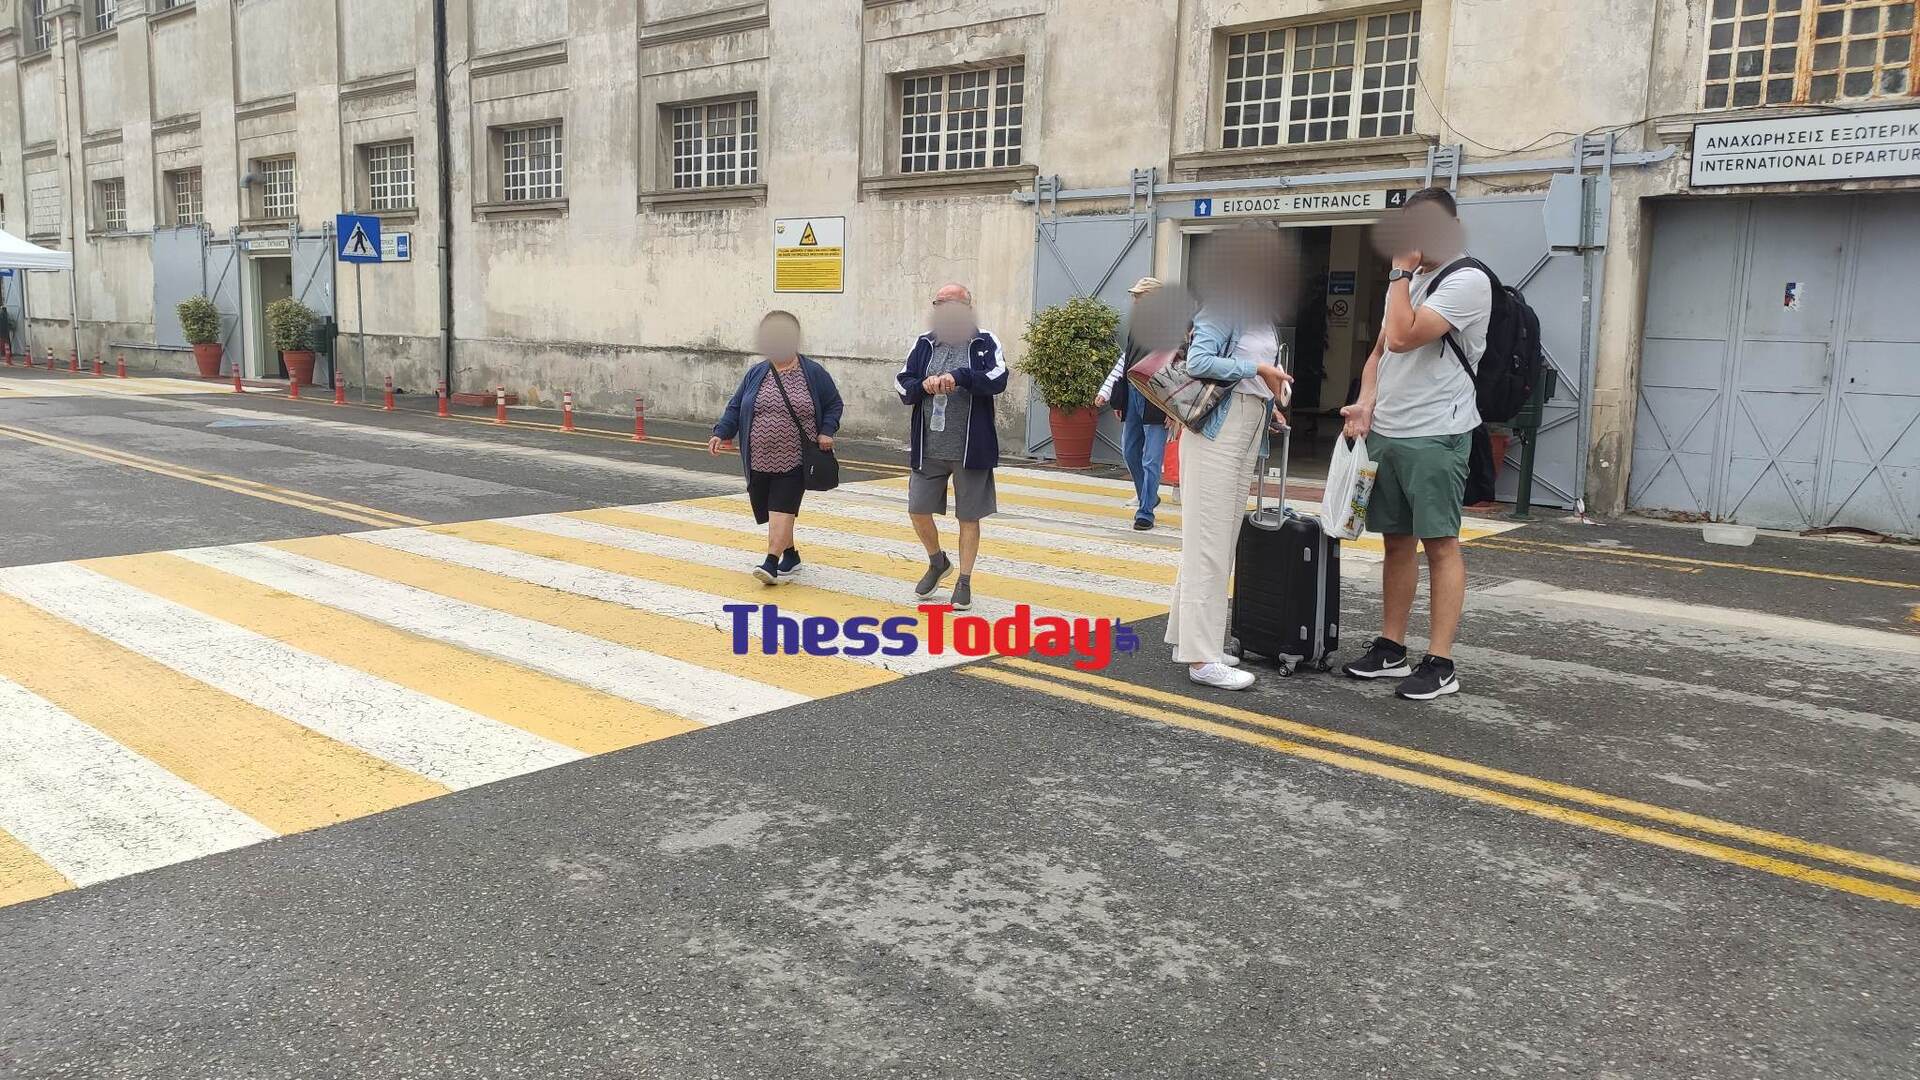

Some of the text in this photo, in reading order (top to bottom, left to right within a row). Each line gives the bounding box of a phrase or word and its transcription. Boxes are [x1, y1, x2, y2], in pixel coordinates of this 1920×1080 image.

[1706, 123, 1919, 149] ΑΝΑΧΩΡΗΣΕΙΣ ΕΞΩΤΕΡΙΚ
[1700, 148, 1920, 172] INTERNATIONAL DEPARTUR
[1223, 199, 1280, 212] ΕΙΣΟΔΟΣ
[1293, 194, 1371, 208] ENTRANCE
